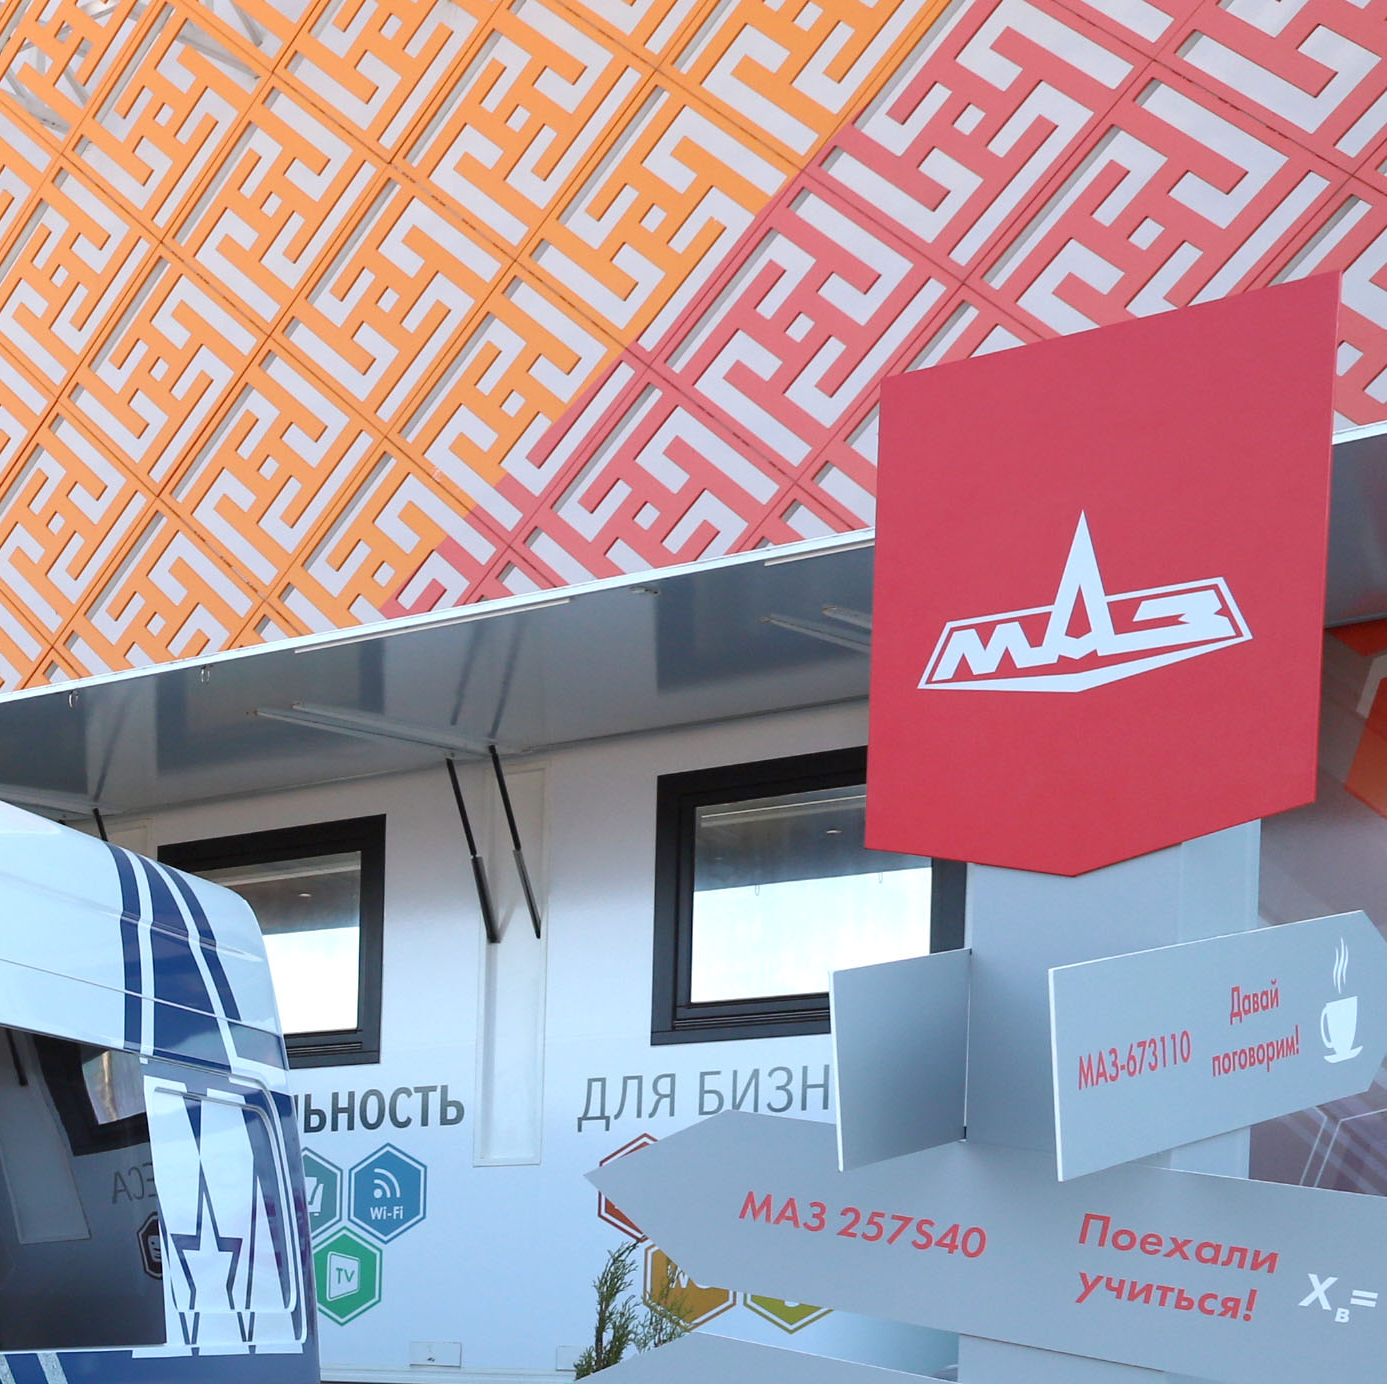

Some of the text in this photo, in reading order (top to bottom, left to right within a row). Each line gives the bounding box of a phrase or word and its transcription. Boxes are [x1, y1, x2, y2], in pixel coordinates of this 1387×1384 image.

[927, 509, 1241, 685] МАЗ
[1229, 980, 1281, 1026] Давай
[1077, 1030, 1193, 1091] МАЗ-673110
[1211, 1027, 1300, 1080] поговорим!
[577, 1064, 830, 1132] ДЛЯ БИЗН
[370, 1206, 404, 1220] Wi-Fi
[738, 1190, 988, 1260] МАЗ 257S40
[1077, 1213, 1280, 1275] Поехали
[336, 1266, 356, 1285] TV
[1074, 1271, 1259, 1322] учиться!
